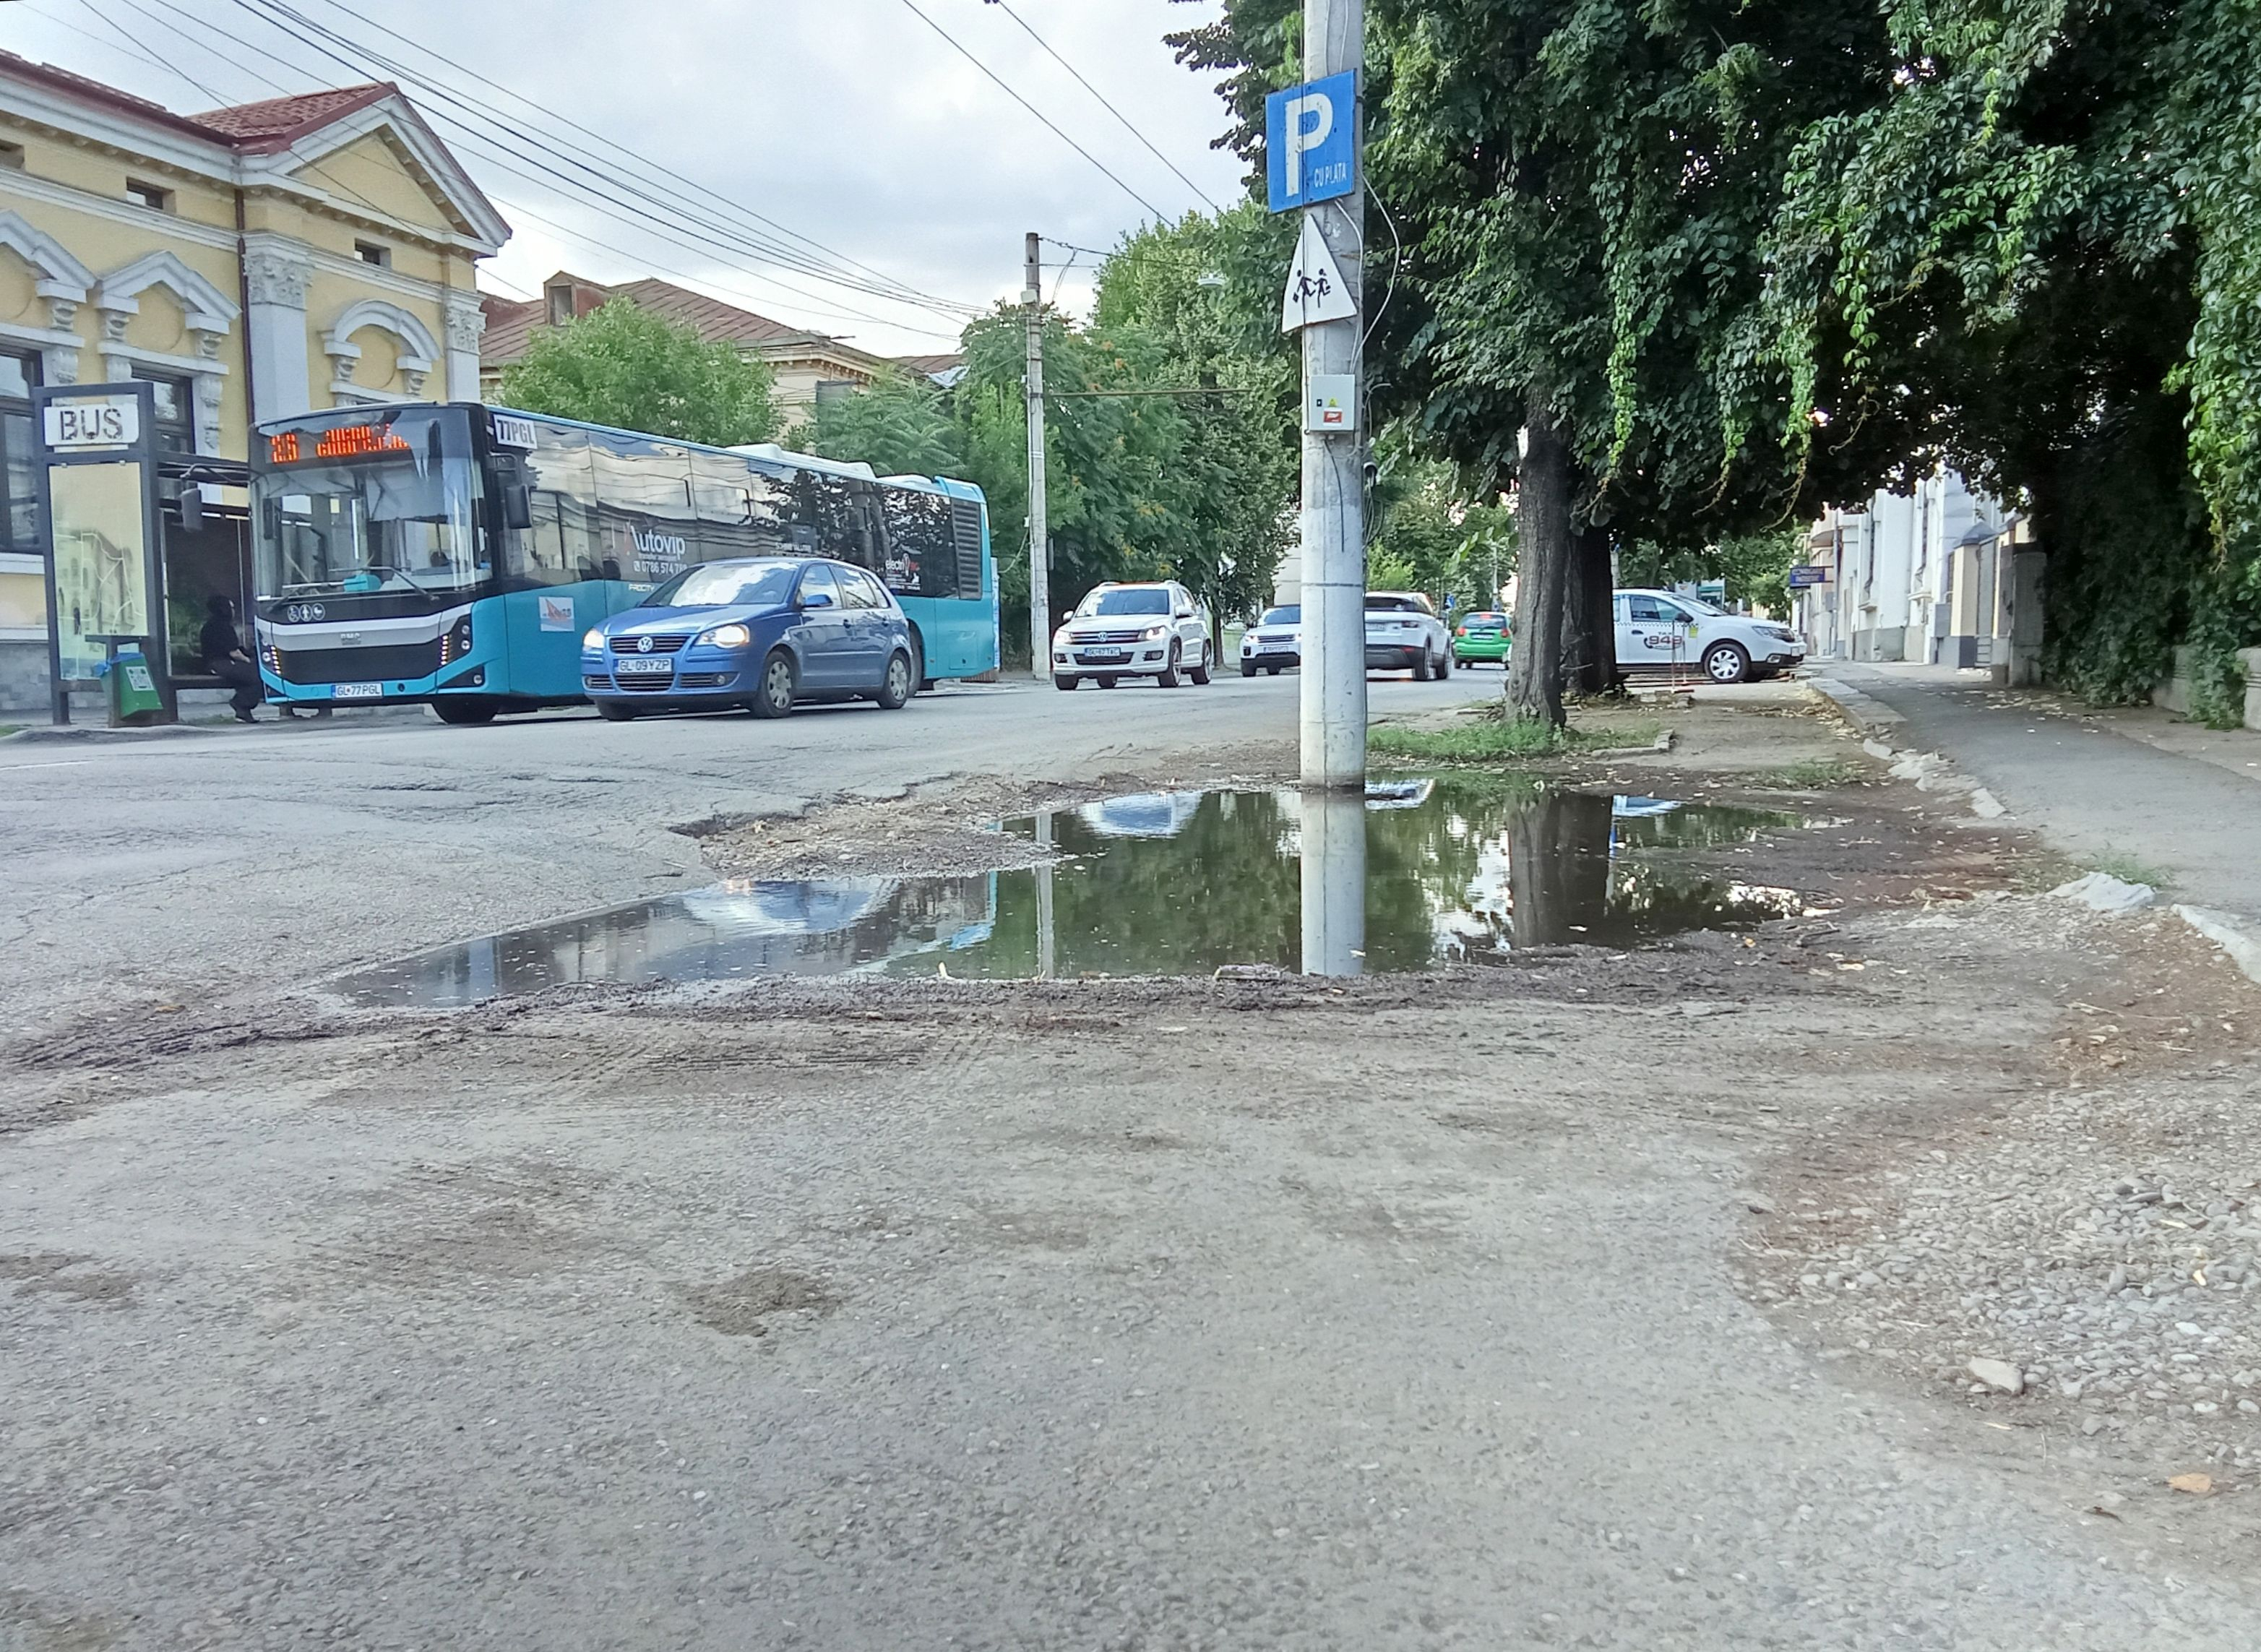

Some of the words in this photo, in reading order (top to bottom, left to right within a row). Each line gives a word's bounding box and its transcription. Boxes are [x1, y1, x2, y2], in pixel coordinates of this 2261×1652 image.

[1285, 93, 1333, 197] P
[1314, 167, 1324, 188] CU
[1325, 162, 1347, 185] PLATA
[60, 408, 123, 440] BUS
[497, 419, 535, 444] 77PGL
